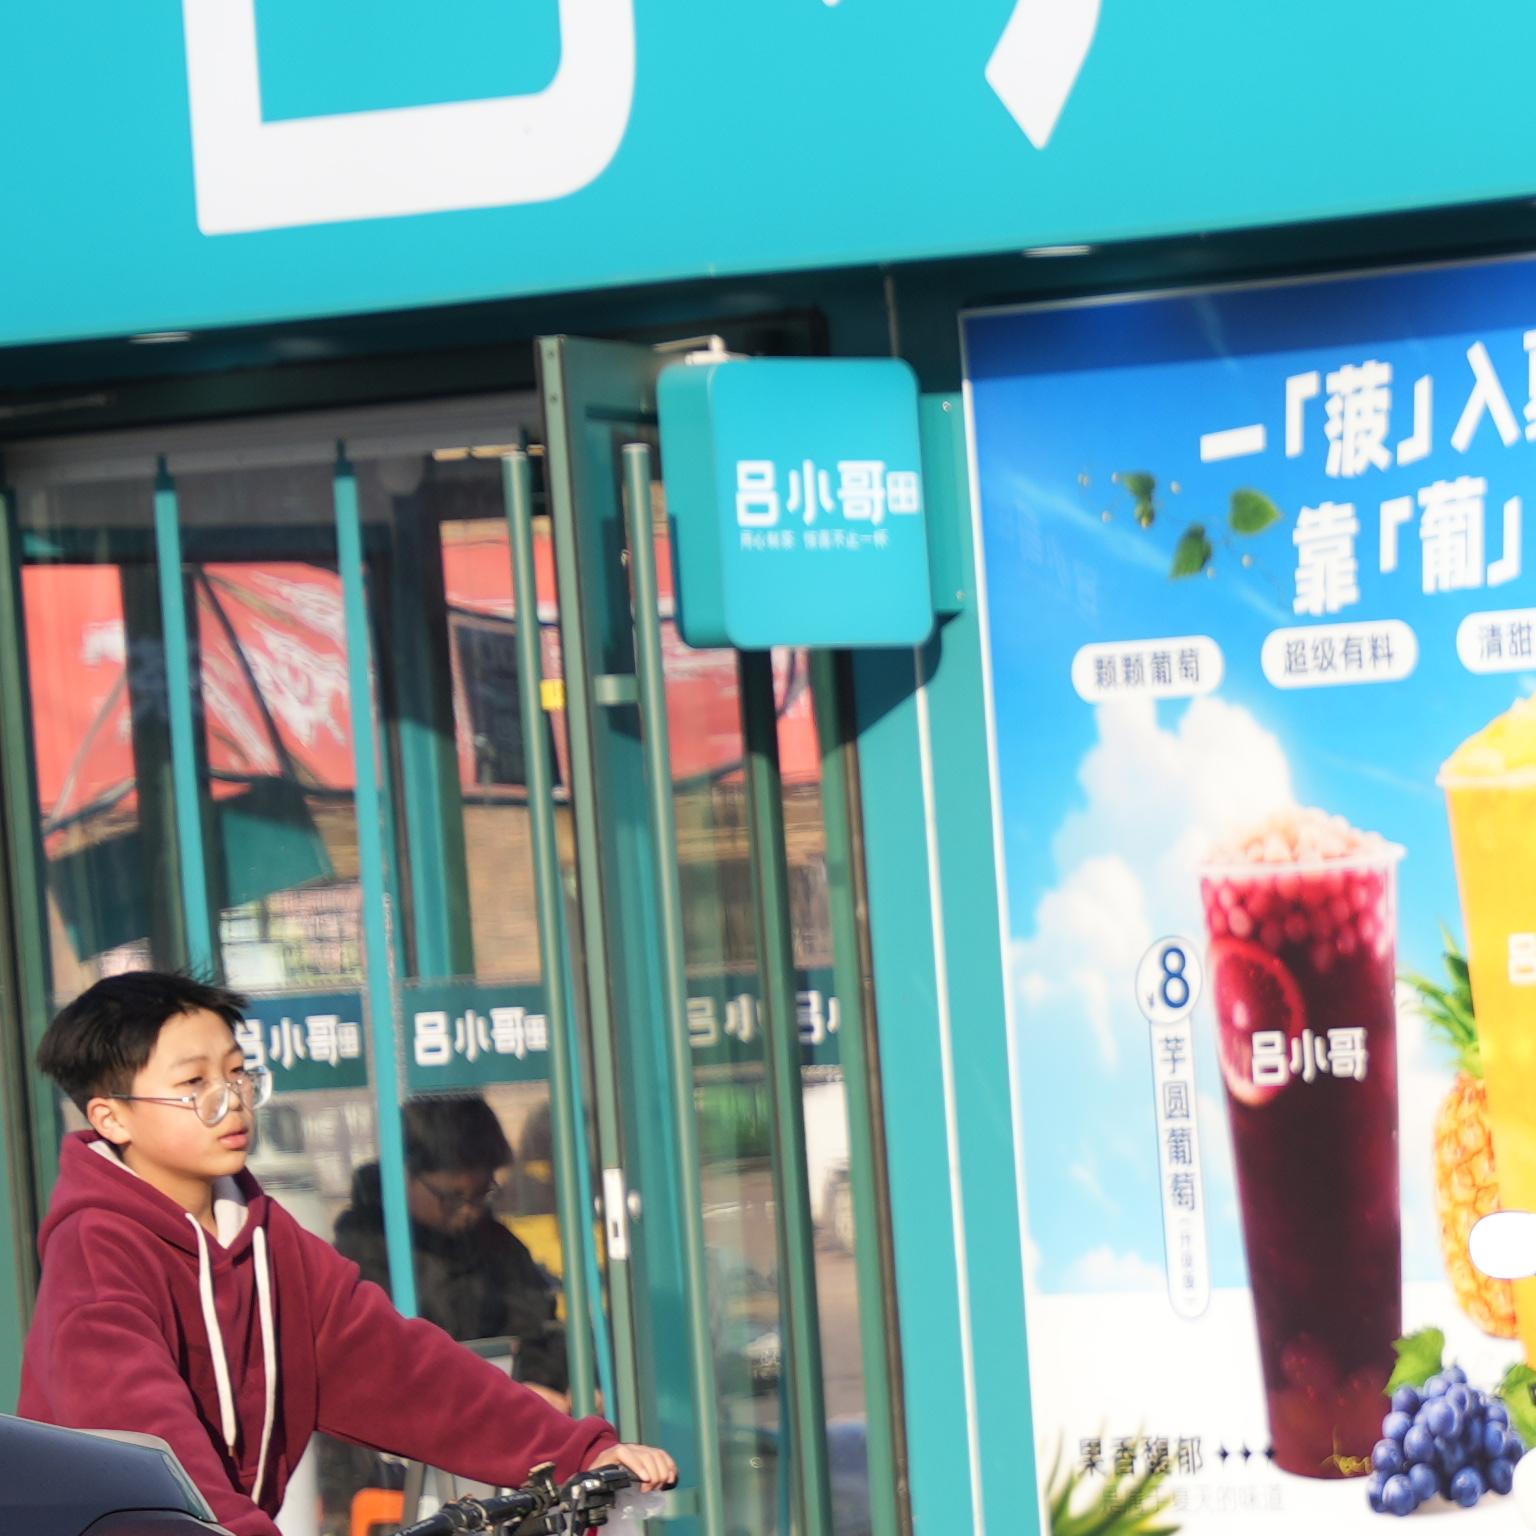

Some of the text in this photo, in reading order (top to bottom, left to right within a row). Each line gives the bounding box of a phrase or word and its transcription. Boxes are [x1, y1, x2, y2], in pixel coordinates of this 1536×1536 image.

[1092, 649, 1202, 695] 颗颗葡萄
[1280, 638, 1396, 682] 超级有料
[1251, 1027, 1369, 1087] 吕小哥
[1157, 1035, 1197, 1212] 芋圆葡萄
